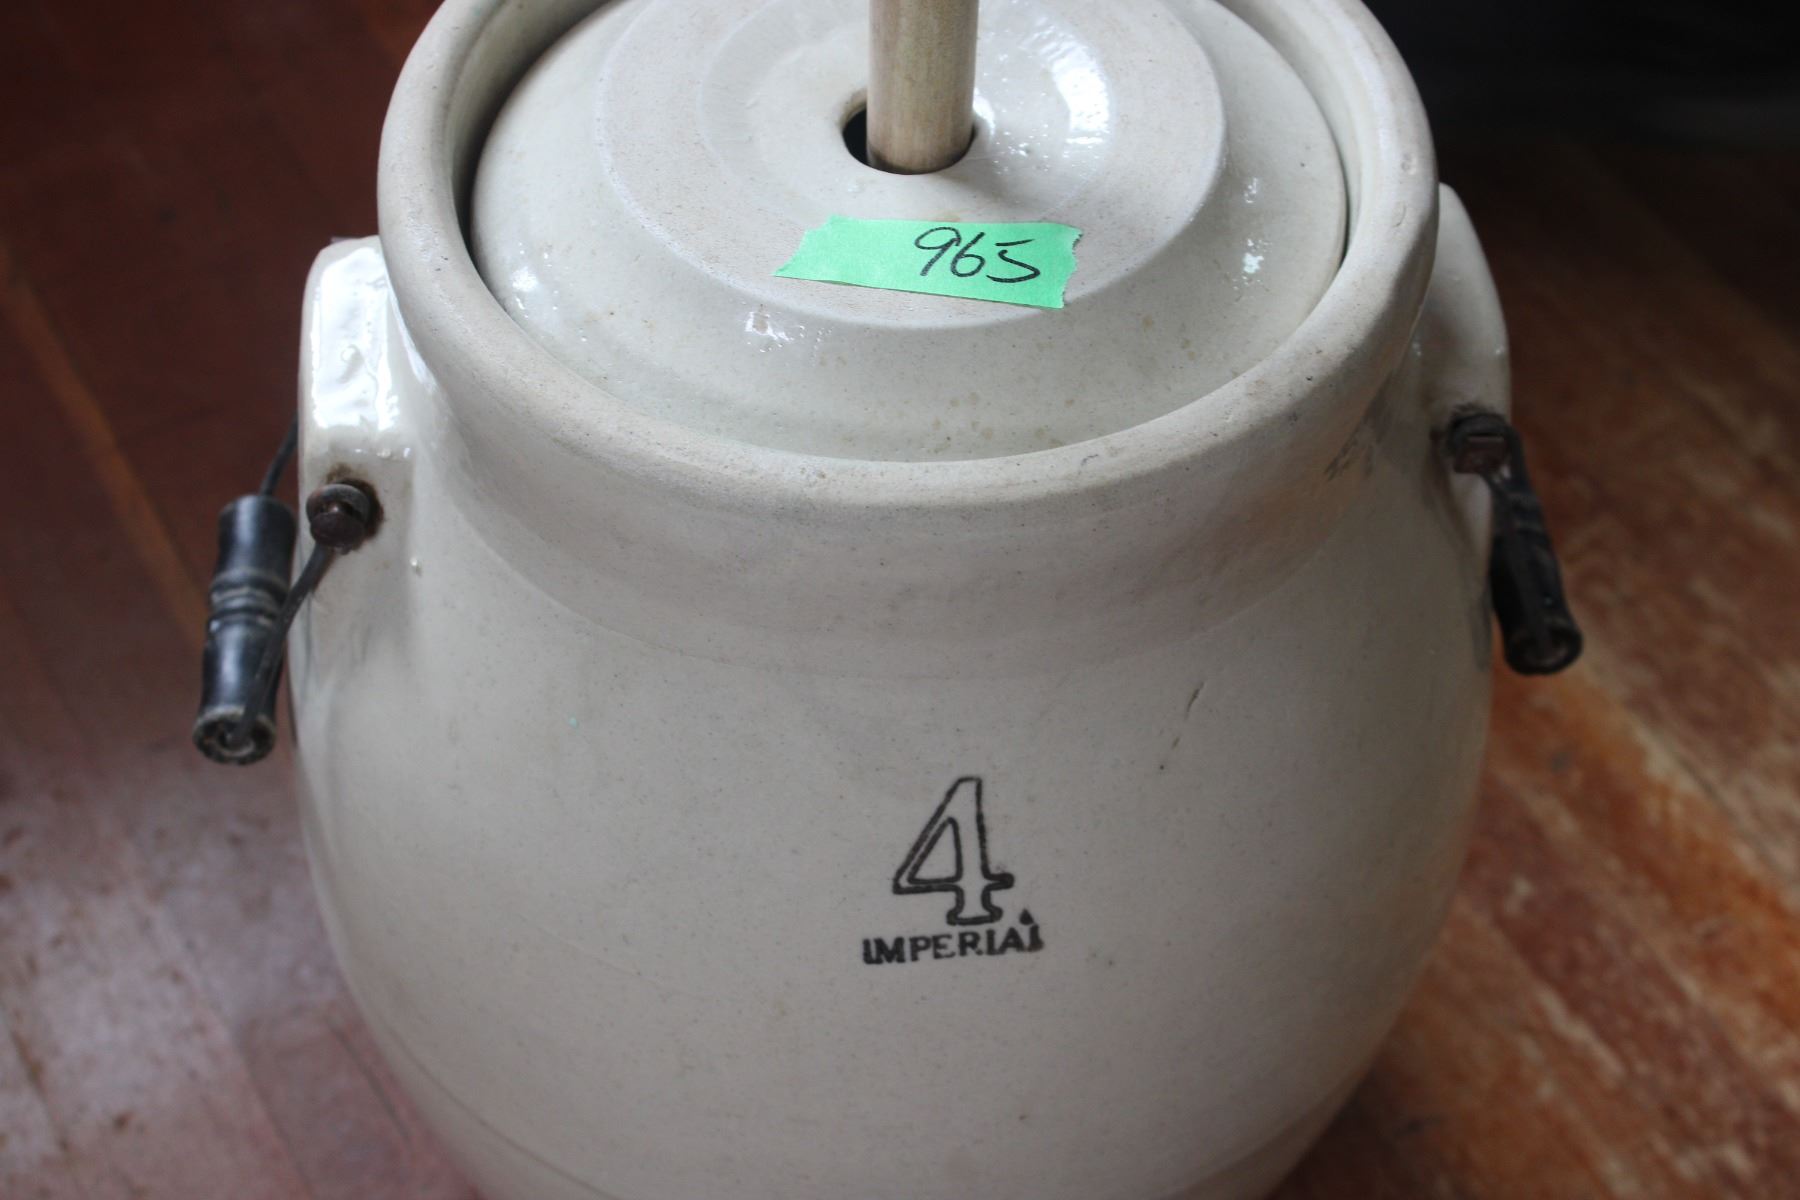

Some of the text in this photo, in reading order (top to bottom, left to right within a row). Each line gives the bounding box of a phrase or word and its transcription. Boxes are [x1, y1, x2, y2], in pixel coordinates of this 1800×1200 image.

[914, 226, 1041, 284] 965
[892, 775, 1016, 927] 4
[861, 923, 1046, 965] IMPERIAL
